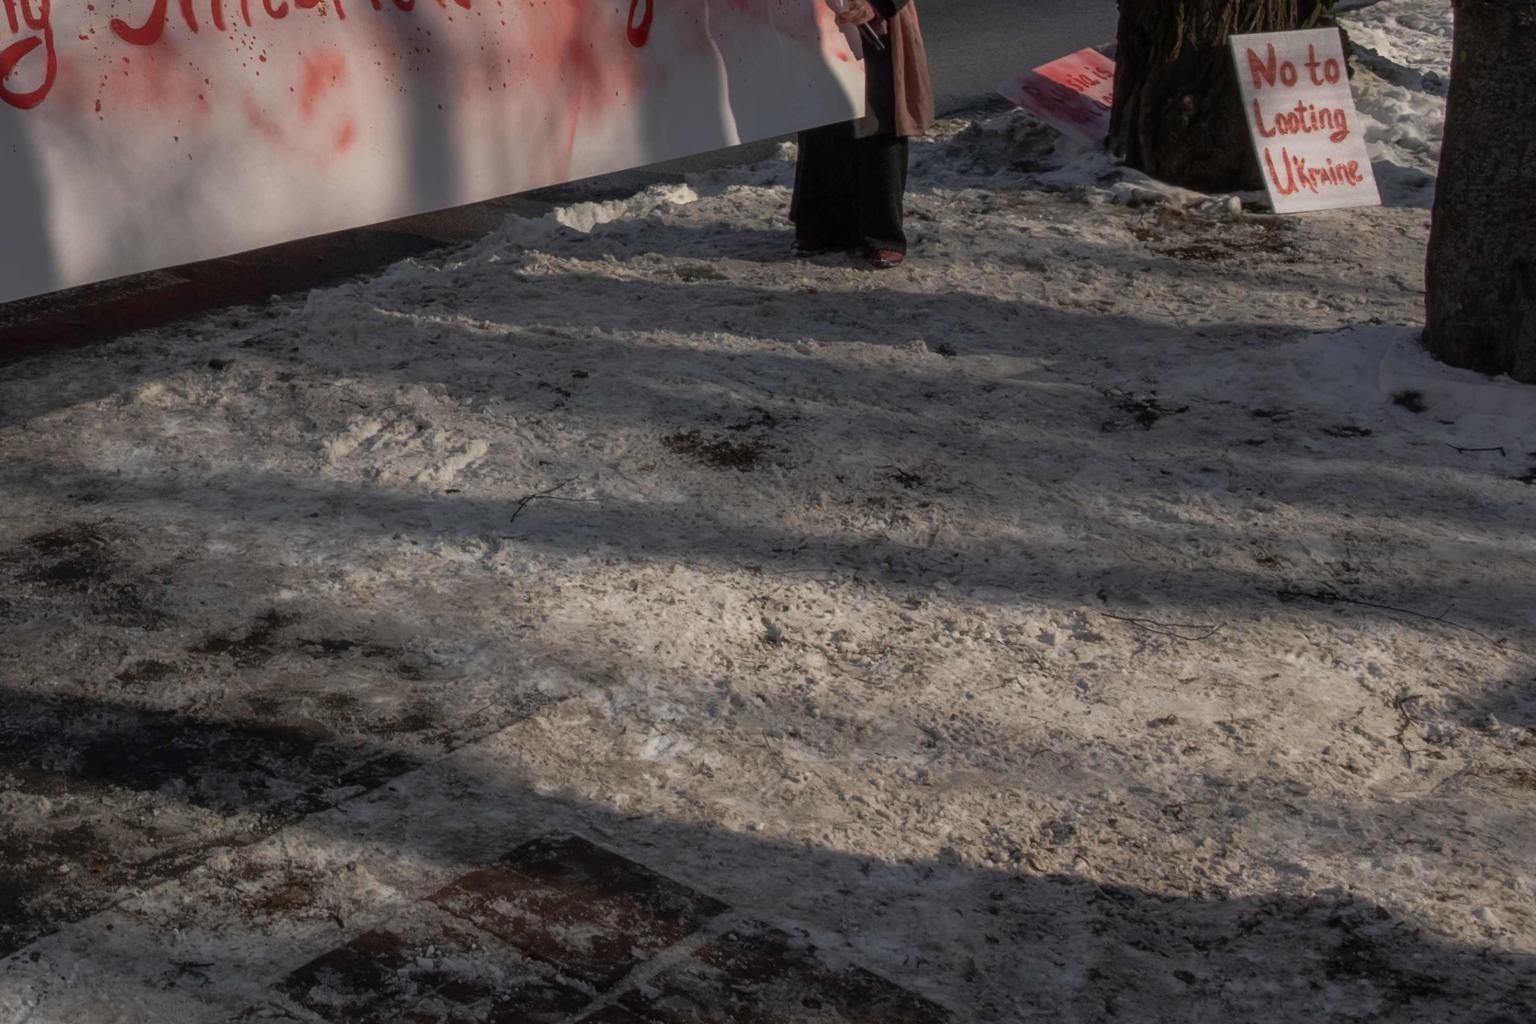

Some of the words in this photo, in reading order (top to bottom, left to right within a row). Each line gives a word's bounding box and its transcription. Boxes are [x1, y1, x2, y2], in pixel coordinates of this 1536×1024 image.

[1247, 44, 1298, 89] No
[1304, 44, 1341, 86] to
[1253, 98, 1351, 144] Looting
